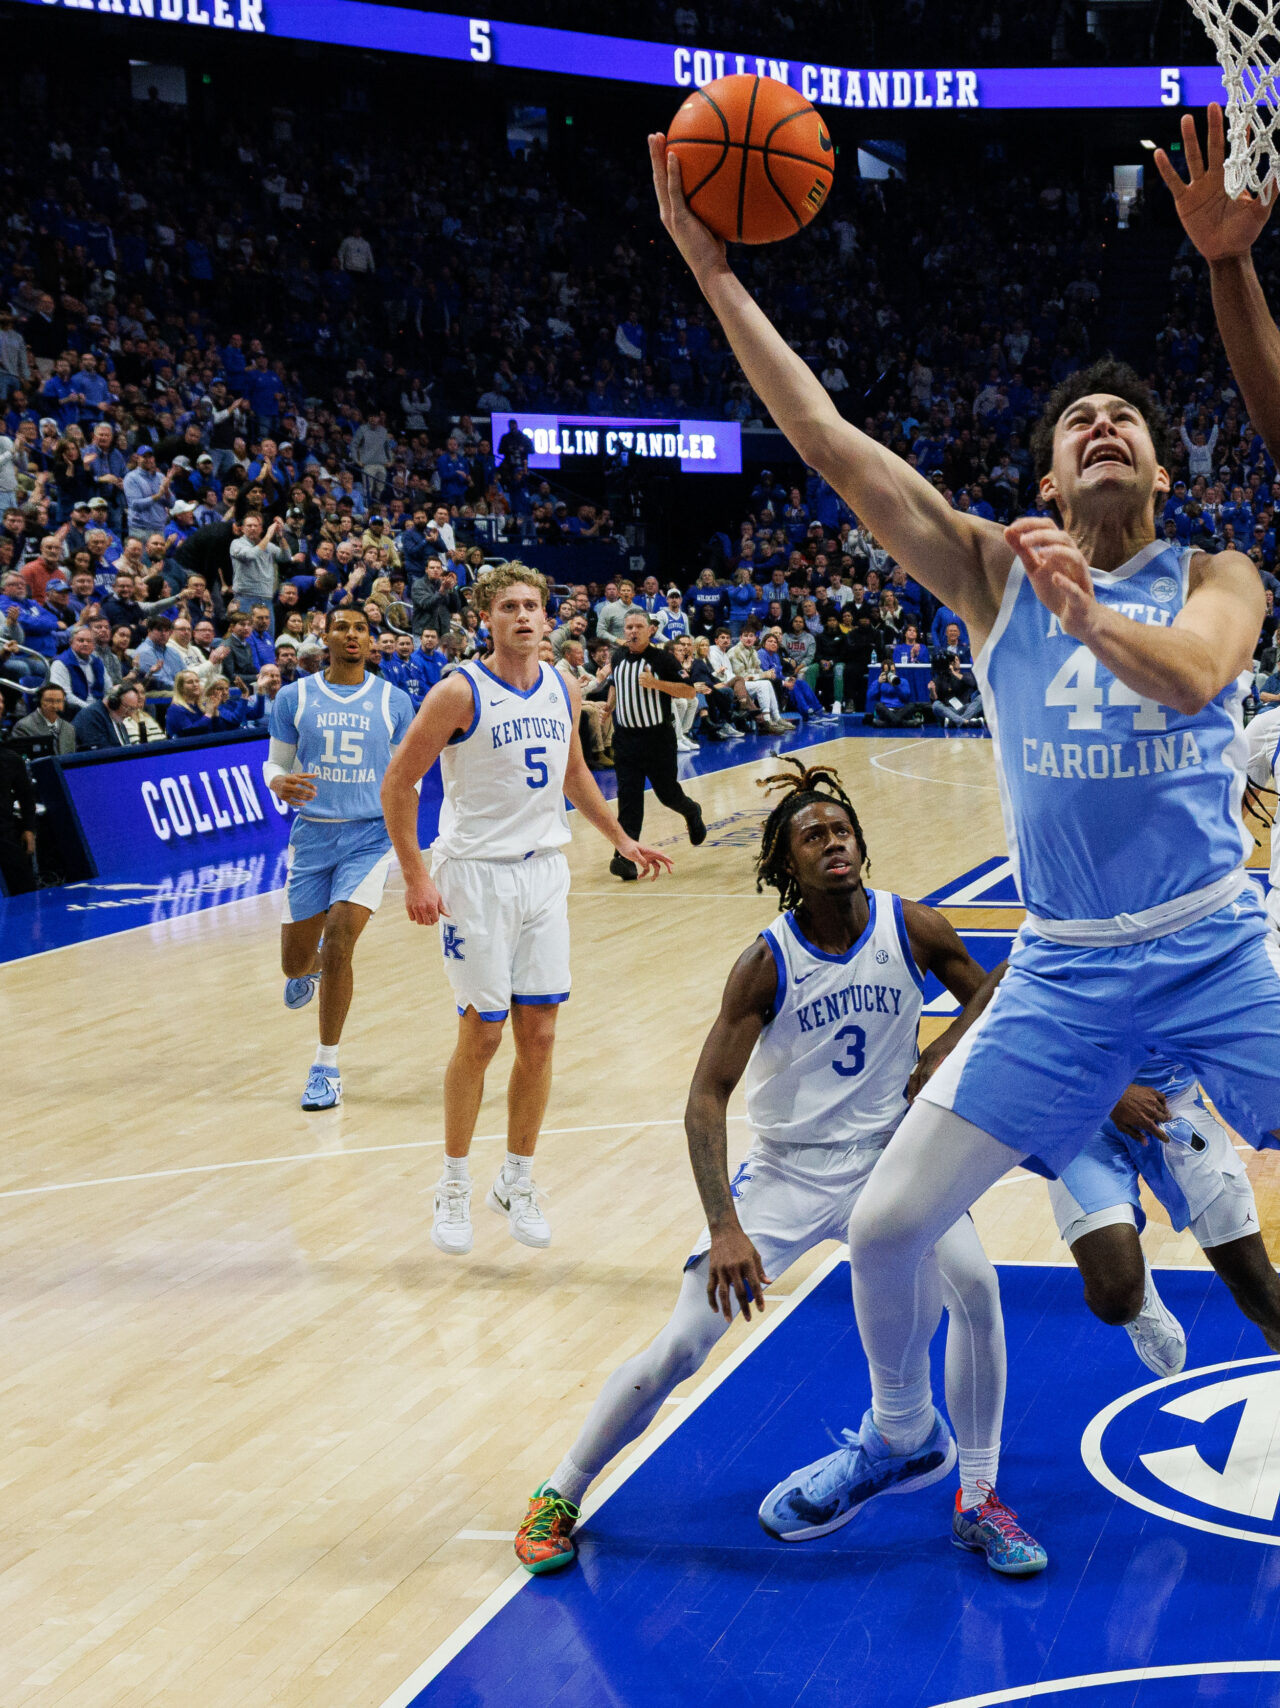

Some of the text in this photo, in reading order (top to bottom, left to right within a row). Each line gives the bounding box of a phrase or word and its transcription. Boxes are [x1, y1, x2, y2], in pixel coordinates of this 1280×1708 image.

[469, 19, 491, 62] 5
[801, 65, 979, 108] CHANDLER
[1160, 69, 1180, 106] 5
[316, 712, 370, 731] NORTH
[491, 717, 567, 750] KENTUCKY
[320, 729, 364, 765] 15
[524, 746, 549, 789] 5
[1022, 732, 1202, 780] CAROLINA
[308, 761, 376, 784] CAROLINA
[141, 764, 264, 841] COLLIN
[796, 984, 902, 1033] KENTUCKY
[832, 1024, 867, 1077] 3
